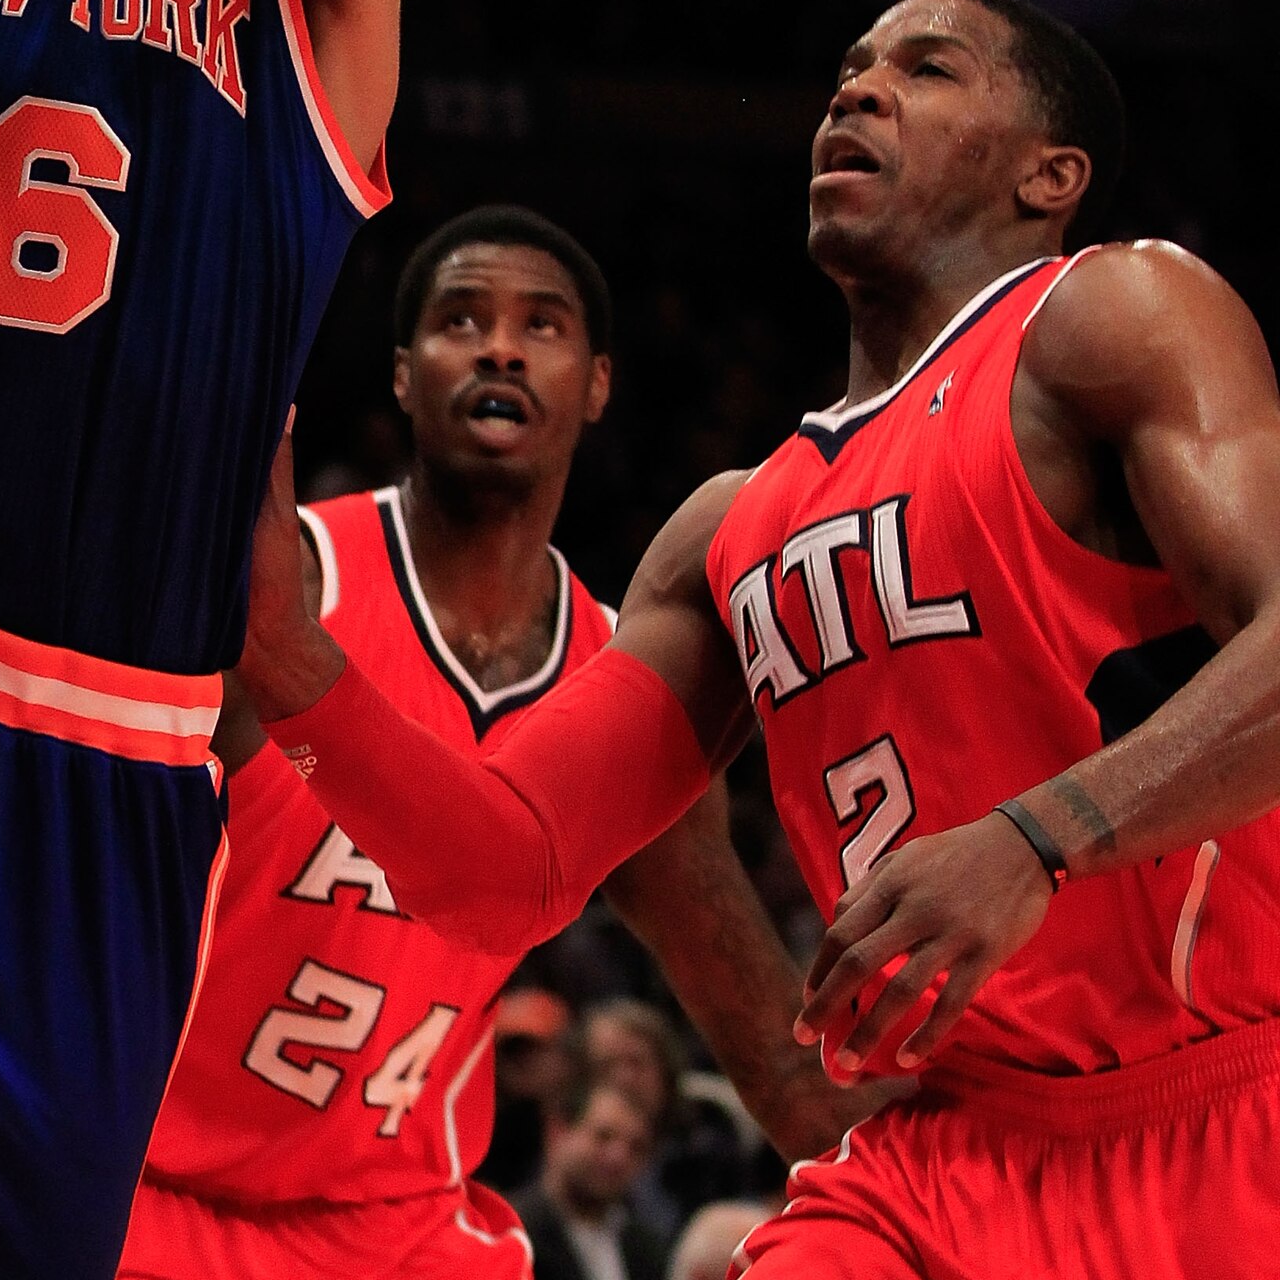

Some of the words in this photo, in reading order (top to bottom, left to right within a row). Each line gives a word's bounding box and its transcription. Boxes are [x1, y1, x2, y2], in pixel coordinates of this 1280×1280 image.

[728, 493, 980, 710] ATL
[824, 734, 916, 903] 2
[242, 957, 461, 1139] 24
